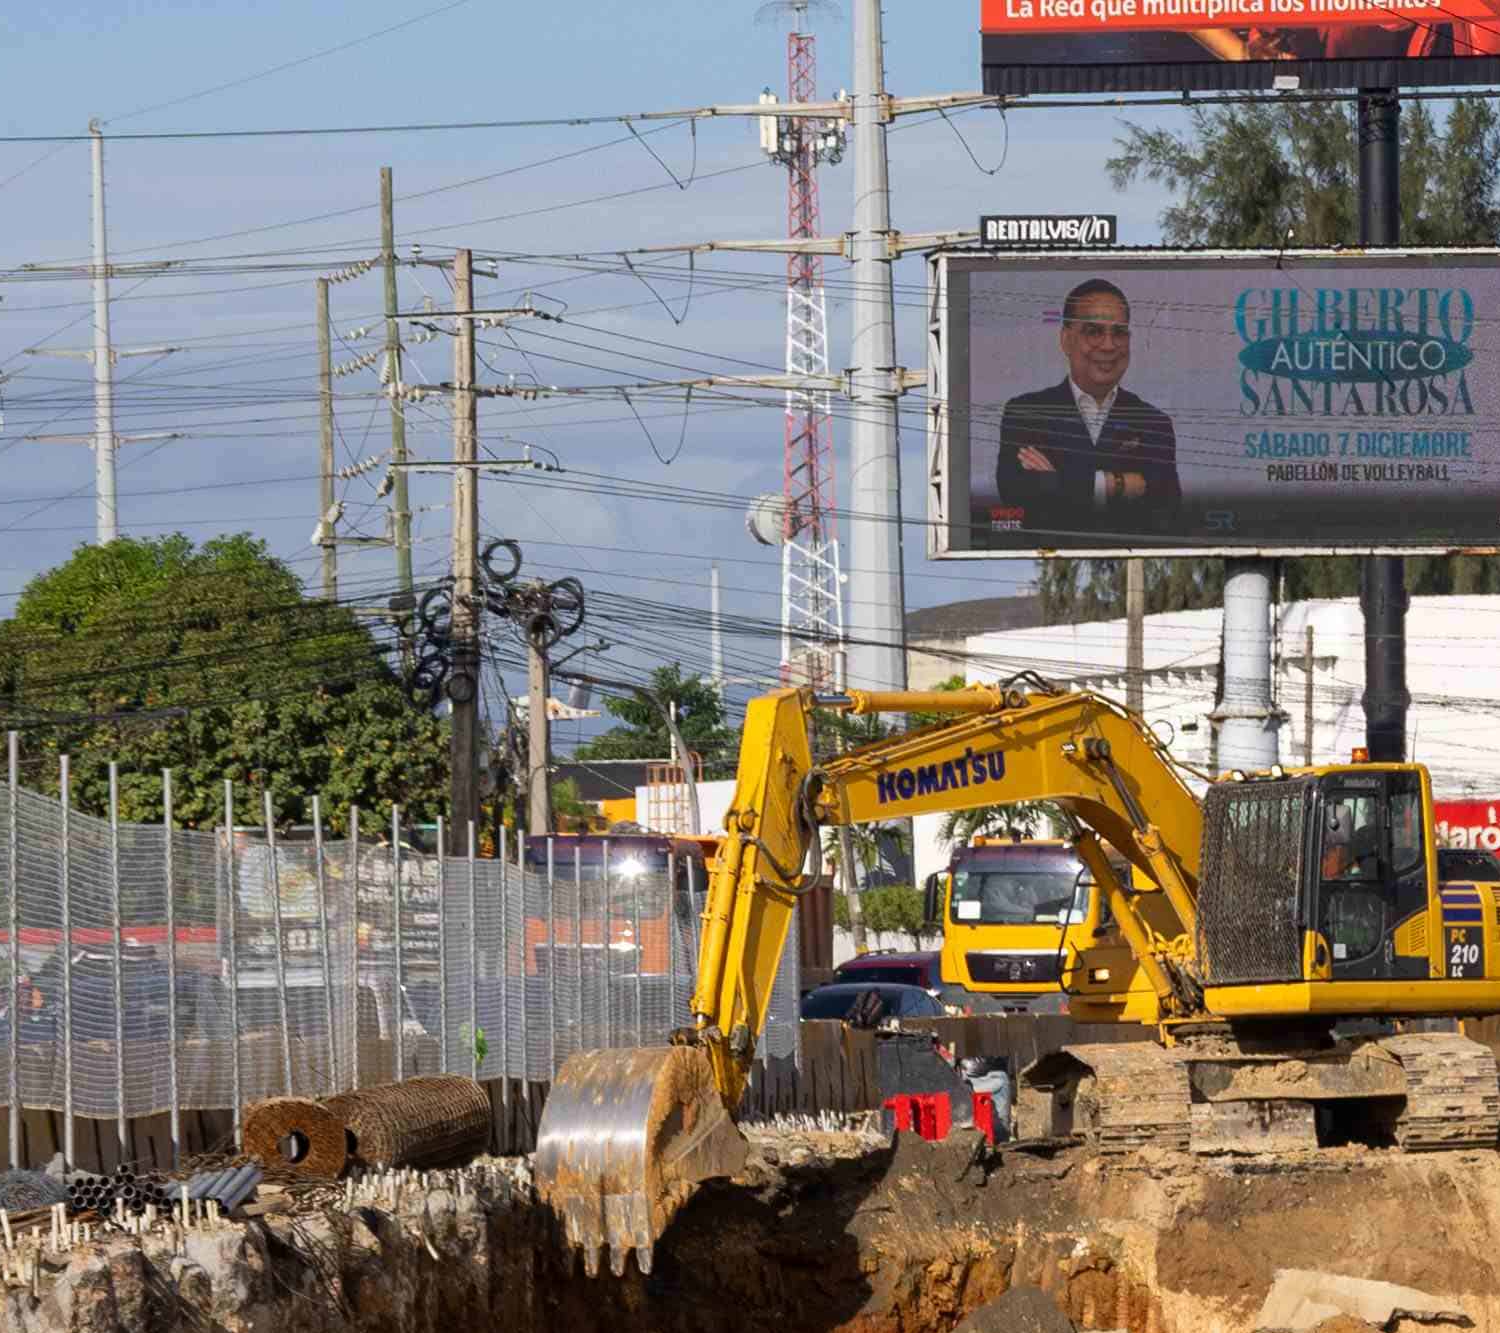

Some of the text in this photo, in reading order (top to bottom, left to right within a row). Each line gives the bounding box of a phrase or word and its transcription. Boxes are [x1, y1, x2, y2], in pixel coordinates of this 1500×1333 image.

[1006, 1, 1033, 18] La
[1040, 0, 1085, 17] Red
[1091, 2, 1136, 22] que
[1143, 0, 1265, 19] multiplica
[1235, 287, 1475, 344] GILBERTO
[1271, 333, 1447, 371] AUTÉNTICO
[1357, 431, 1473, 458] DICIEMBRE
[877, 747, 1006, 804] KOMATSU
[1450, 929, 1467, 943] PC
[1450, 944, 1479, 964] 210
[1451, 965, 1463, 978] LC
